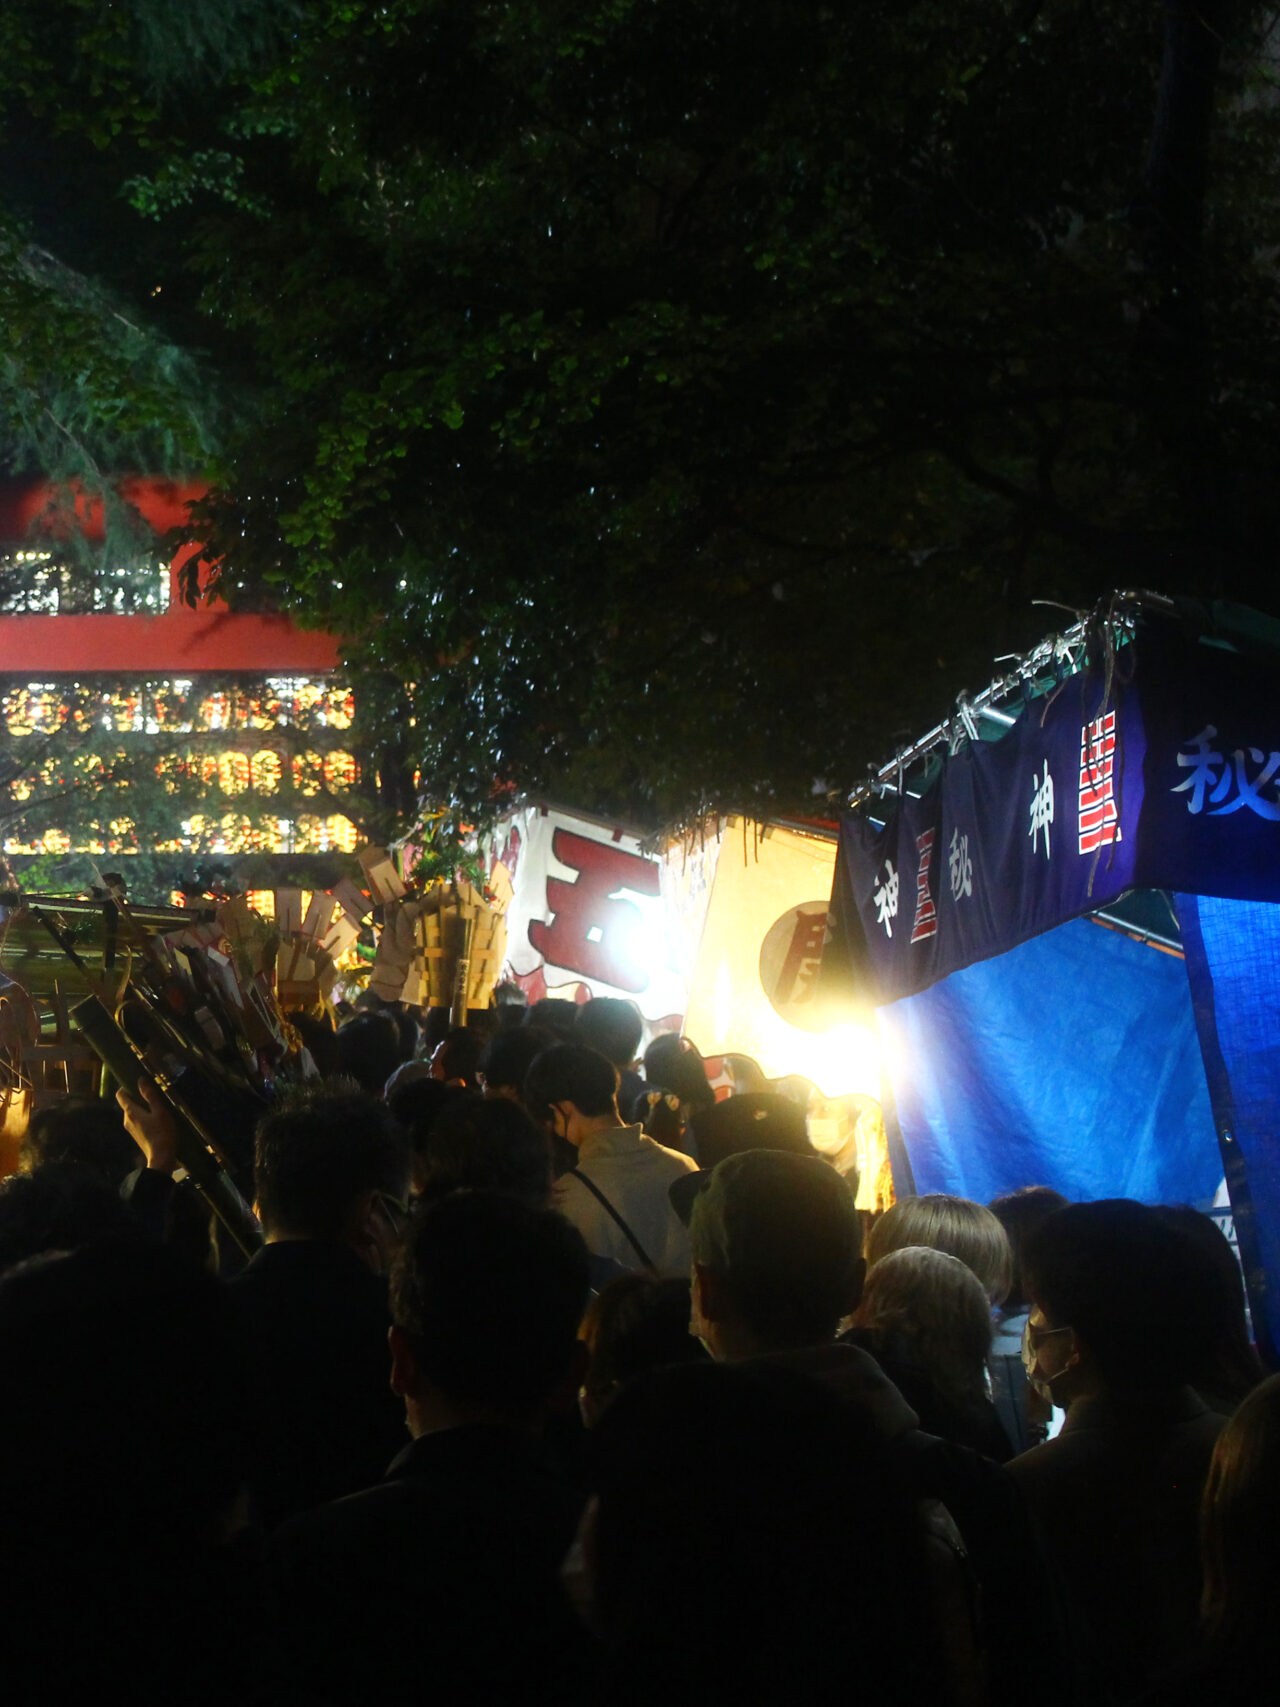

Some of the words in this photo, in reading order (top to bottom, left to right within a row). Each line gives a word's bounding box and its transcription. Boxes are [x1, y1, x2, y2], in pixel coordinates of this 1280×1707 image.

[1030, 758, 1054, 860] 神
[1169, 723, 1280, 821] 秘
[874, 859, 901, 938] 神
[949, 828, 973, 902] 秘
